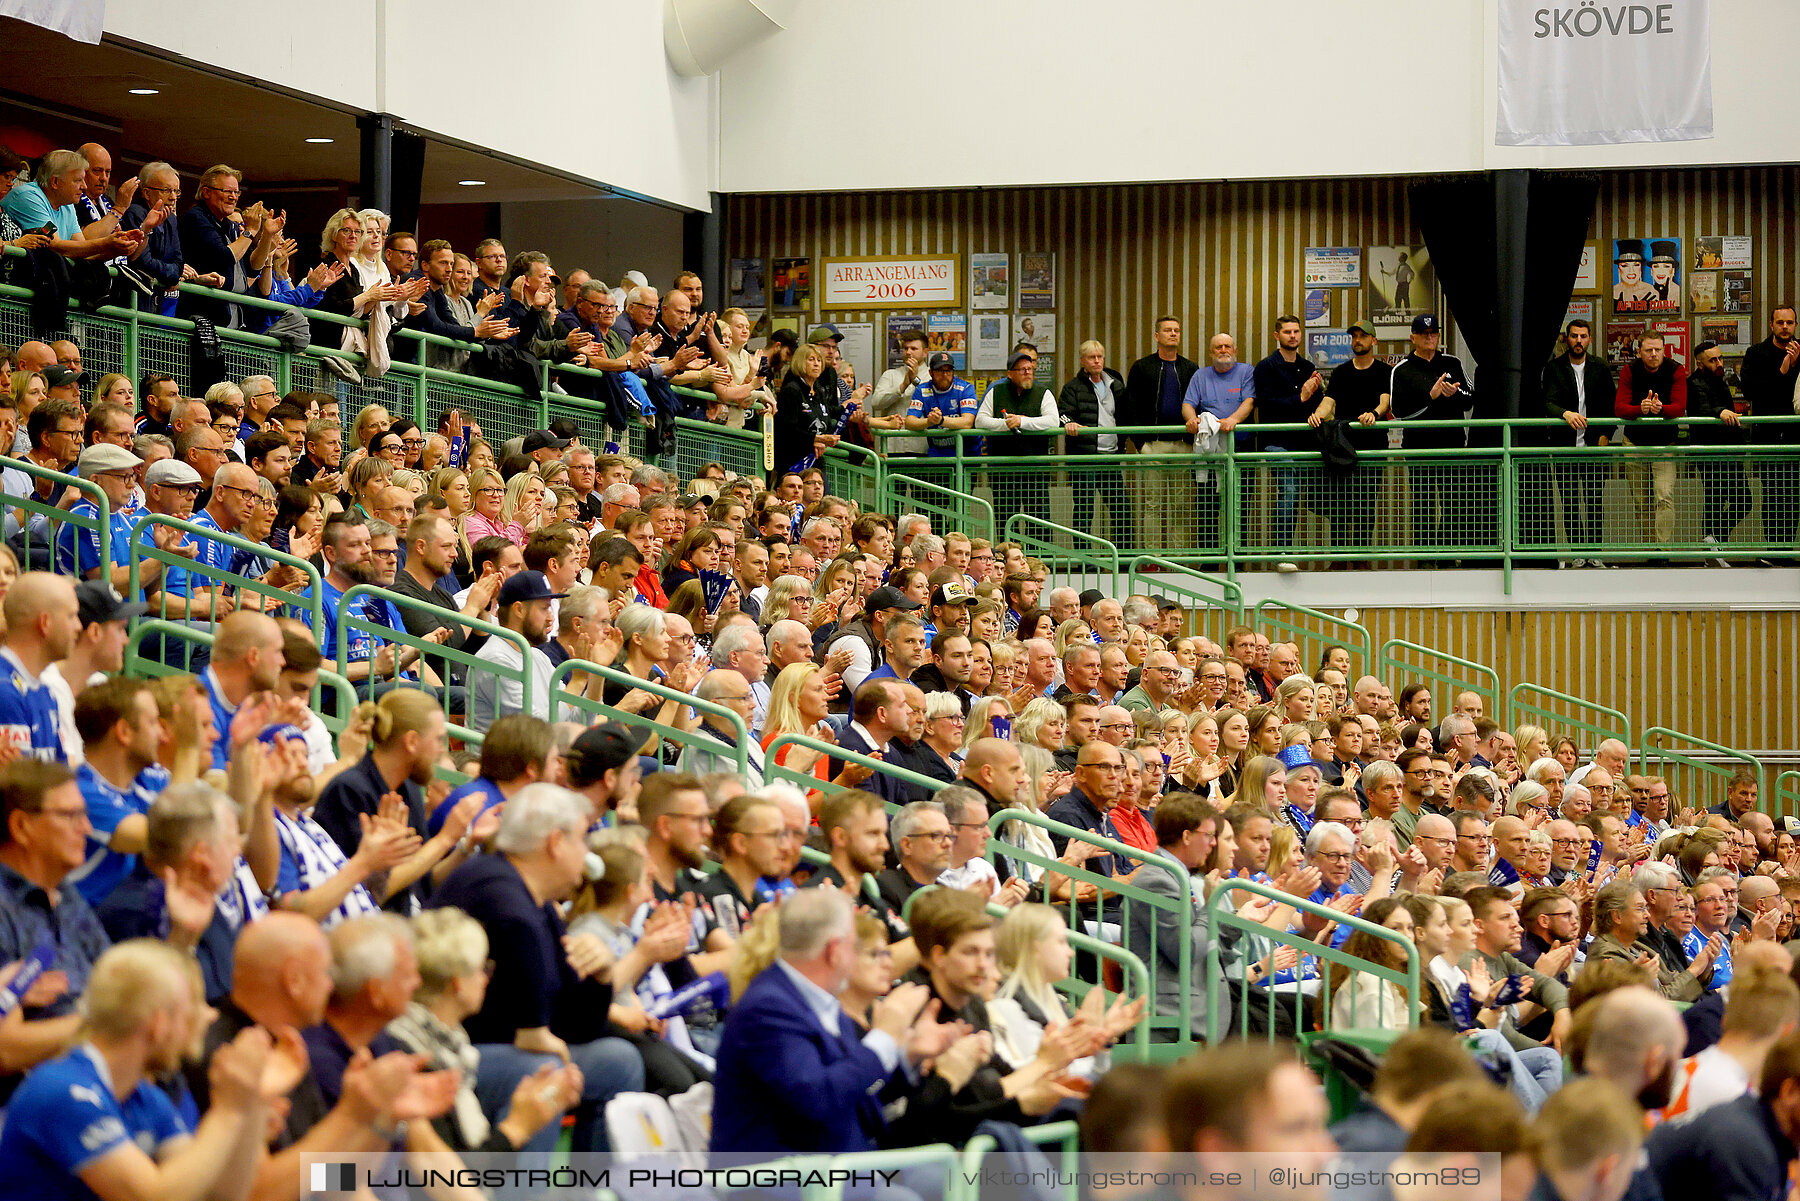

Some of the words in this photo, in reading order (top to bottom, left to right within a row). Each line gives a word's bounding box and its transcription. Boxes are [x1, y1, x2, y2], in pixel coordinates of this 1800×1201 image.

[1534, 1, 1673, 38] SKÖVDE
[833, 264, 948, 283] ARRANGEMANG
[865, 283, 917, 299] 2006
[1617, 301, 1647, 311] AFTER
[1649, 300, 1676, 309] DARK
[1373, 315, 1403, 324] BJÖRN
[1313, 335, 1328, 345] SM
[941, 353, 949, 361] B
